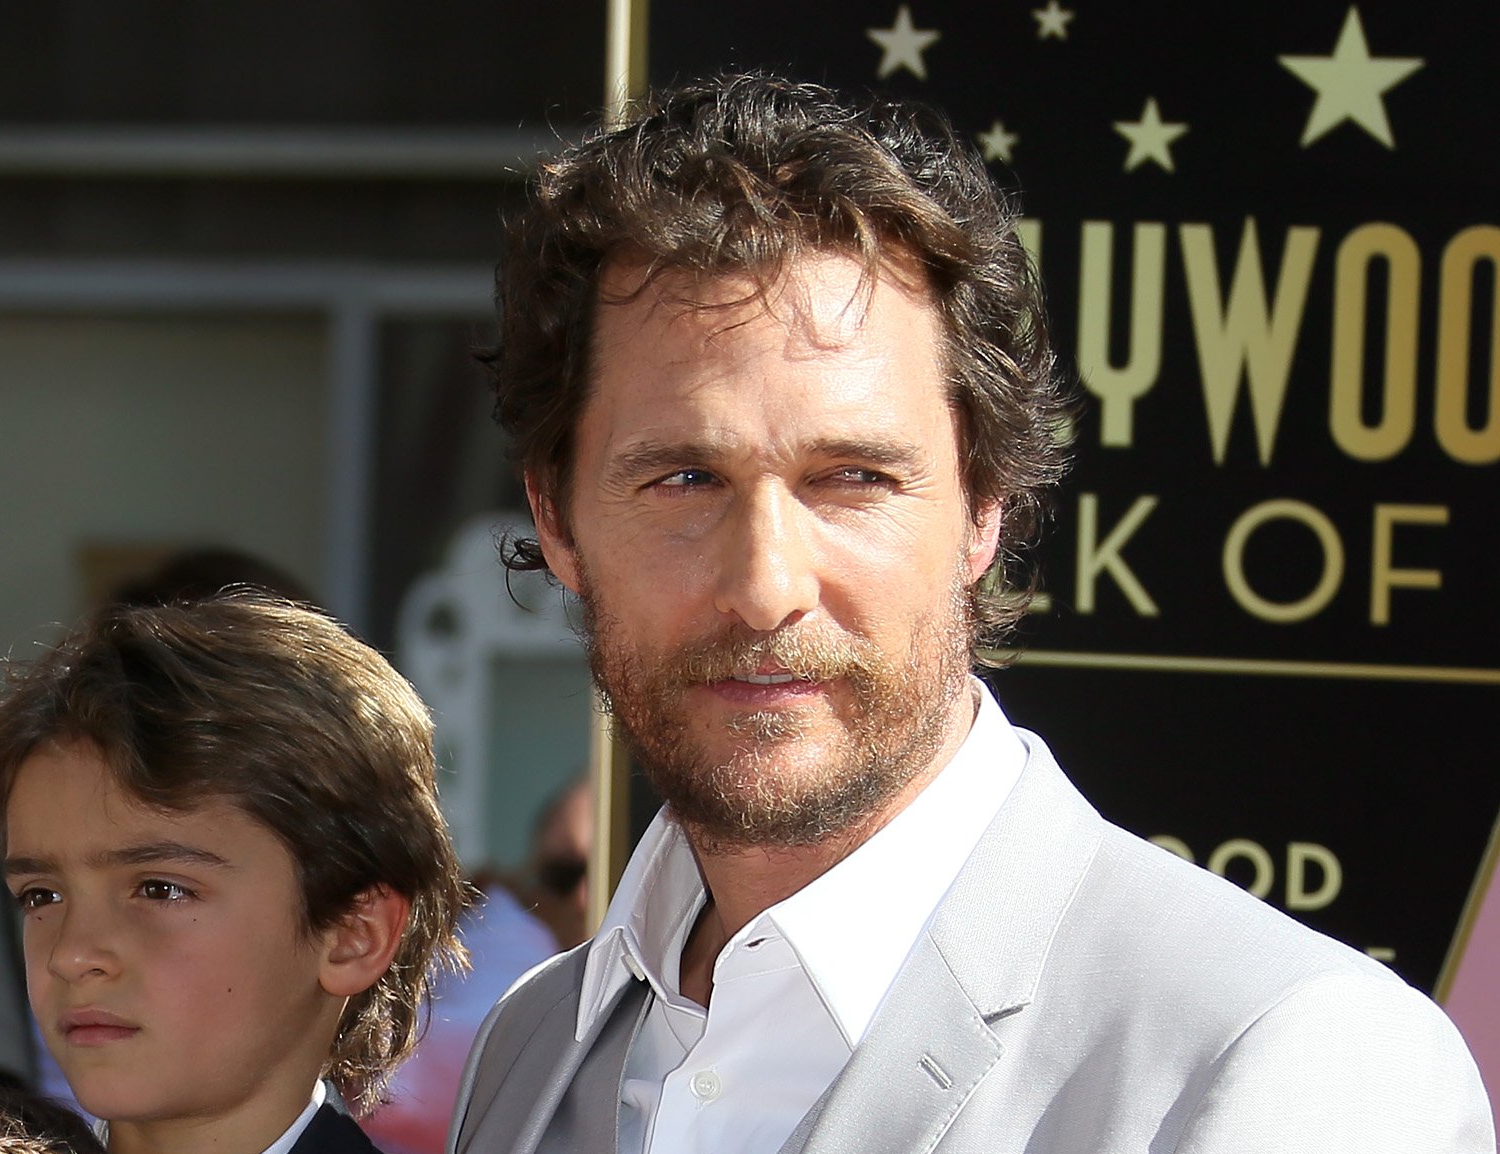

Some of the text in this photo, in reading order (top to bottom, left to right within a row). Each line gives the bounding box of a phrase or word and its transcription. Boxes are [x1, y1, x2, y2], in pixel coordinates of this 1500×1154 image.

[1017, 216, 1500, 467] YWOO
[1222, 498, 1450, 626] OF
[1148, 834, 1343, 911] OD
